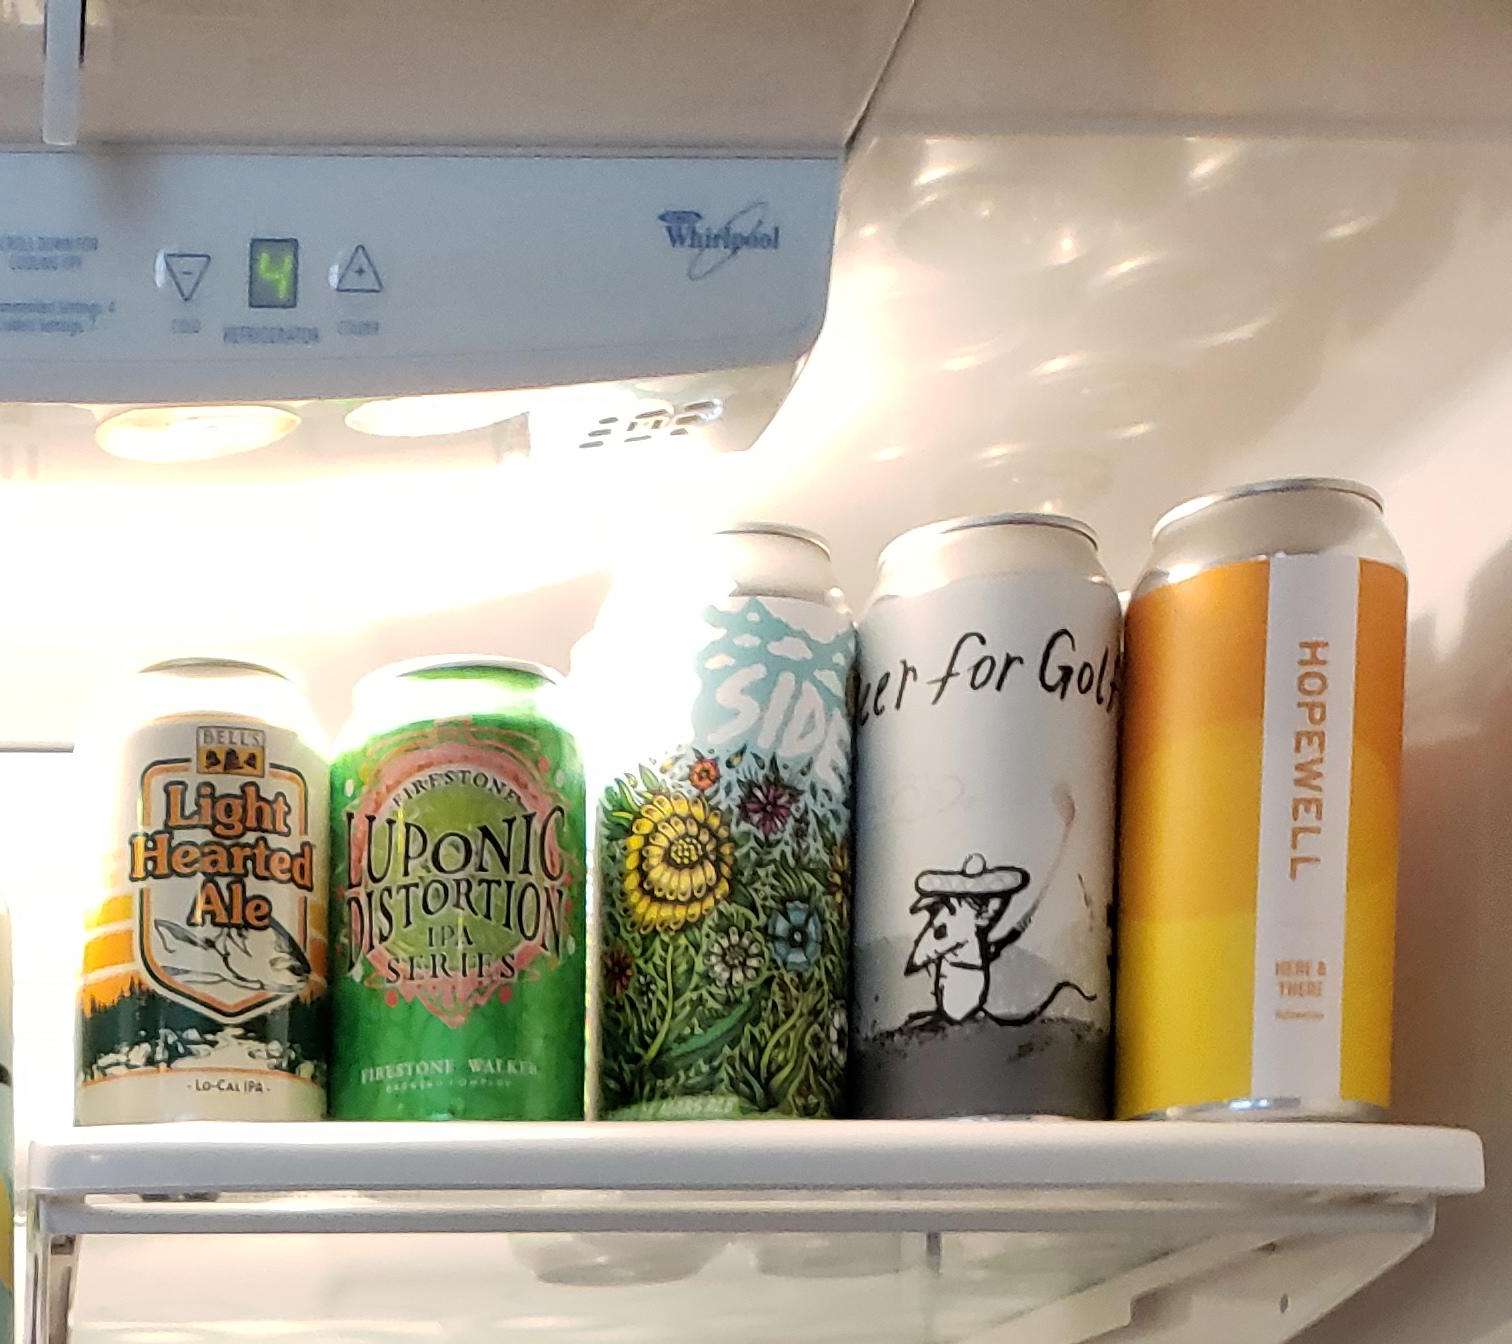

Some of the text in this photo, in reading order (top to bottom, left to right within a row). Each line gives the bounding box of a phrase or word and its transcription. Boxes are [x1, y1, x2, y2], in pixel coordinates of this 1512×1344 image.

[259, 251, 292, 298] 4
[931, 632, 1024, 705] for
[392, 769, 524, 808] FIRESTONE
[1288, 639, 1330, 882] HOPEWELL
[164, 782, 291, 838] Light
[129, 832, 315, 890] Hearted
[346, 804, 566, 890] LUPONIC
[188, 876, 276, 931] Ale
[346, 876, 566, 974] DISTORTION
[427, 926, 474, 948] IPA
[387, 953, 516, 984] SERIES
